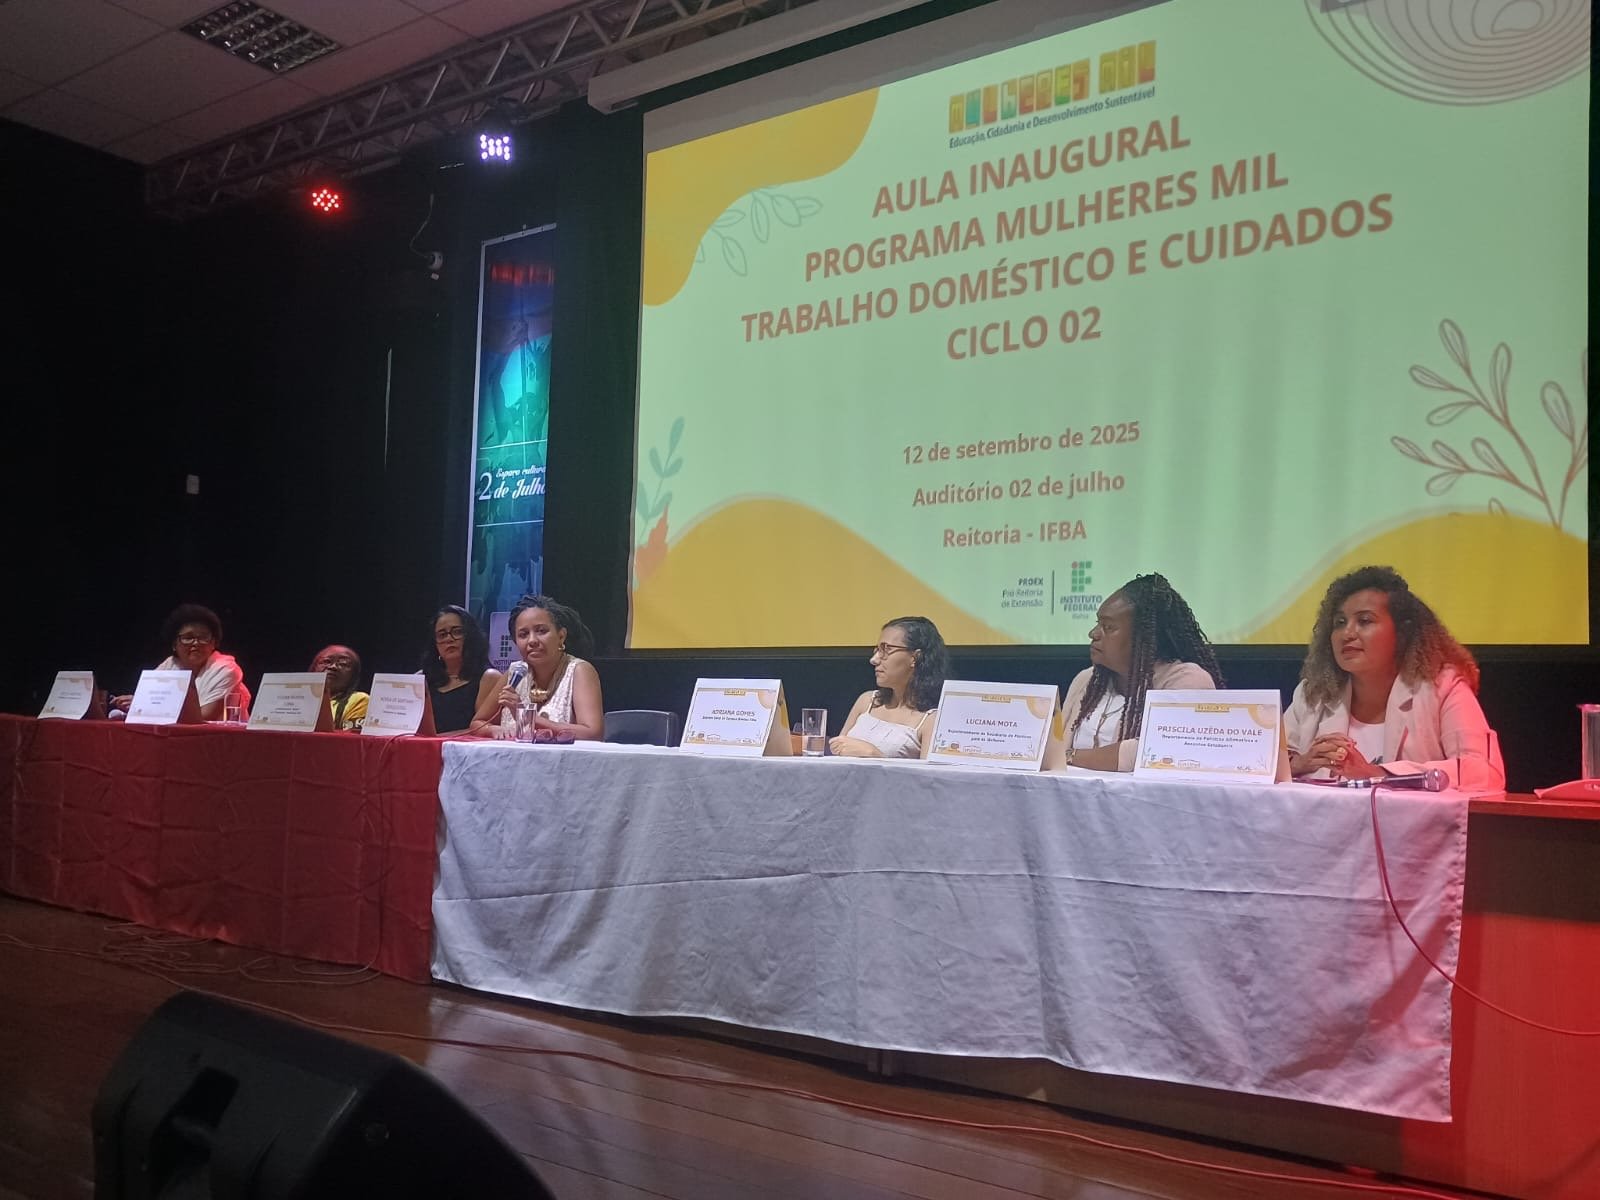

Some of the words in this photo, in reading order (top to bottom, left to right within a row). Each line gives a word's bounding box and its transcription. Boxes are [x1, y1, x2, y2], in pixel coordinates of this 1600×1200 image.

[986, 120, 1024, 139] Cidadania
[1026, 120, 1032, 128] e
[1033, 101, 1104, 127] Desenvolvimento
[1105, 87, 1155, 109] Sustentável
[872, 170, 959, 217] AULA
[970, 115, 1191, 195] INAUGURAL
[805, 217, 985, 282] PROGRAMA
[996, 171, 1197, 243] MULHERES
[1211, 152, 1288, 200] MIL
[741, 287, 898, 342] TRABALHO
[909, 247, 1114, 314] DOMÉSTICO
[1128, 240, 1147, 275] E
[1160, 193, 1393, 269] CUIDADOS
[947, 315, 1048, 360] CICLO
[1059, 306, 1102, 343] 02
[903, 445, 923, 464] 12
[928, 442, 950, 461] de
[956, 433, 1052, 459] setembro
[1059, 428, 1083, 448] de
[1090, 421, 1140, 445] 2025
[479, 472, 492, 500] 2
[494, 480, 509, 499] de
[912, 480, 1003, 507] Auditório
[1009, 478, 1032, 497] 02
[1038, 475, 1063, 496] de
[1067, 470, 1125, 499] julho
[943, 524, 1021, 547] Reitoria
[1040, 519, 1087, 542] IFBA
[1018, 577, 1044, 586] PROEX
[1011, 599, 1043, 608] Extensão
[1060, 595, 1102, 604] INSTITUTO
[1064, 603, 1098, 612] FEDERAL
[966, 718, 996, 727] LUCIANA
[998, 719, 1018, 728] MOTA
[1157, 725, 1196, 734] PRISCILA
[1227, 728, 1240, 736] DO
[1242, 728, 1263, 736] VALE
